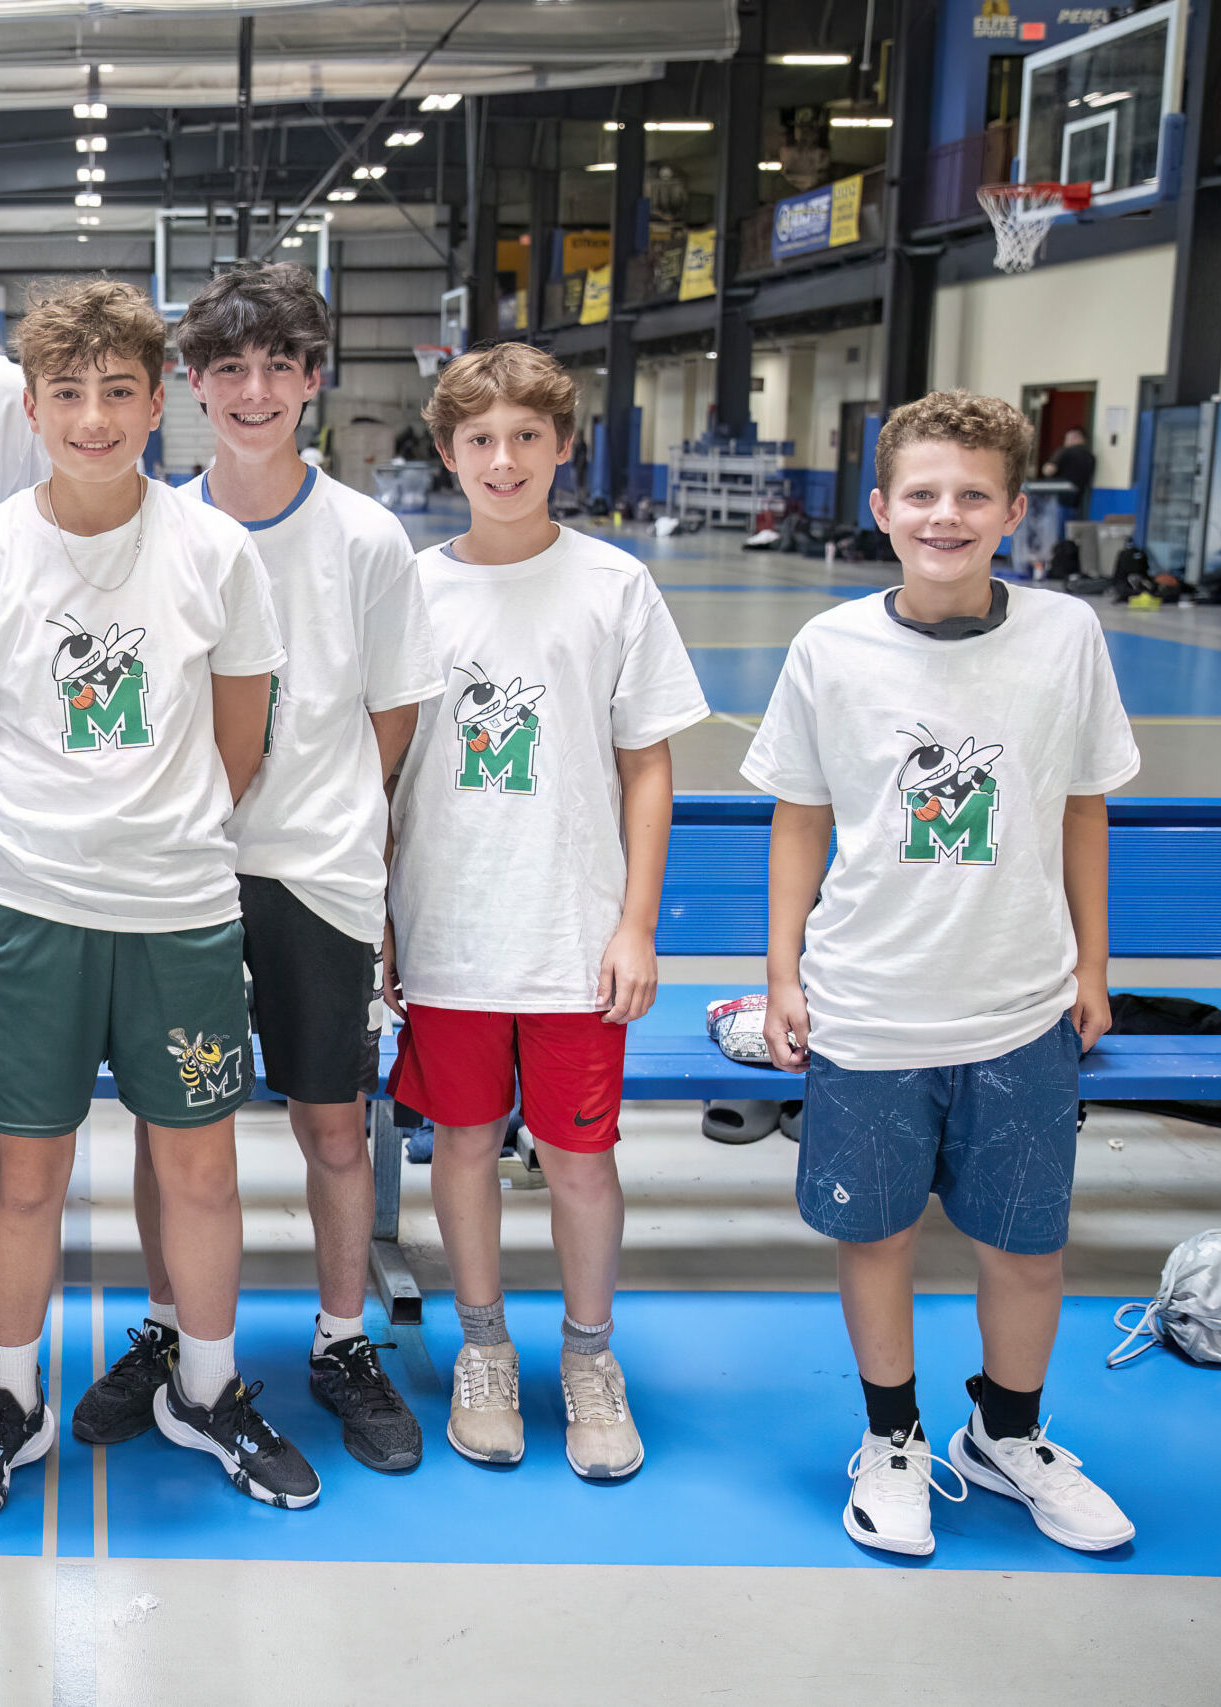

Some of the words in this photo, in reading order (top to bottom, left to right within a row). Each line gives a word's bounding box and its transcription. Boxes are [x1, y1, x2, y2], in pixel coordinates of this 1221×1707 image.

[57, 672, 155, 753] M
[455, 723, 542, 796] M
[899, 789, 1000, 866] M
[186, 1045, 242, 1107] M
